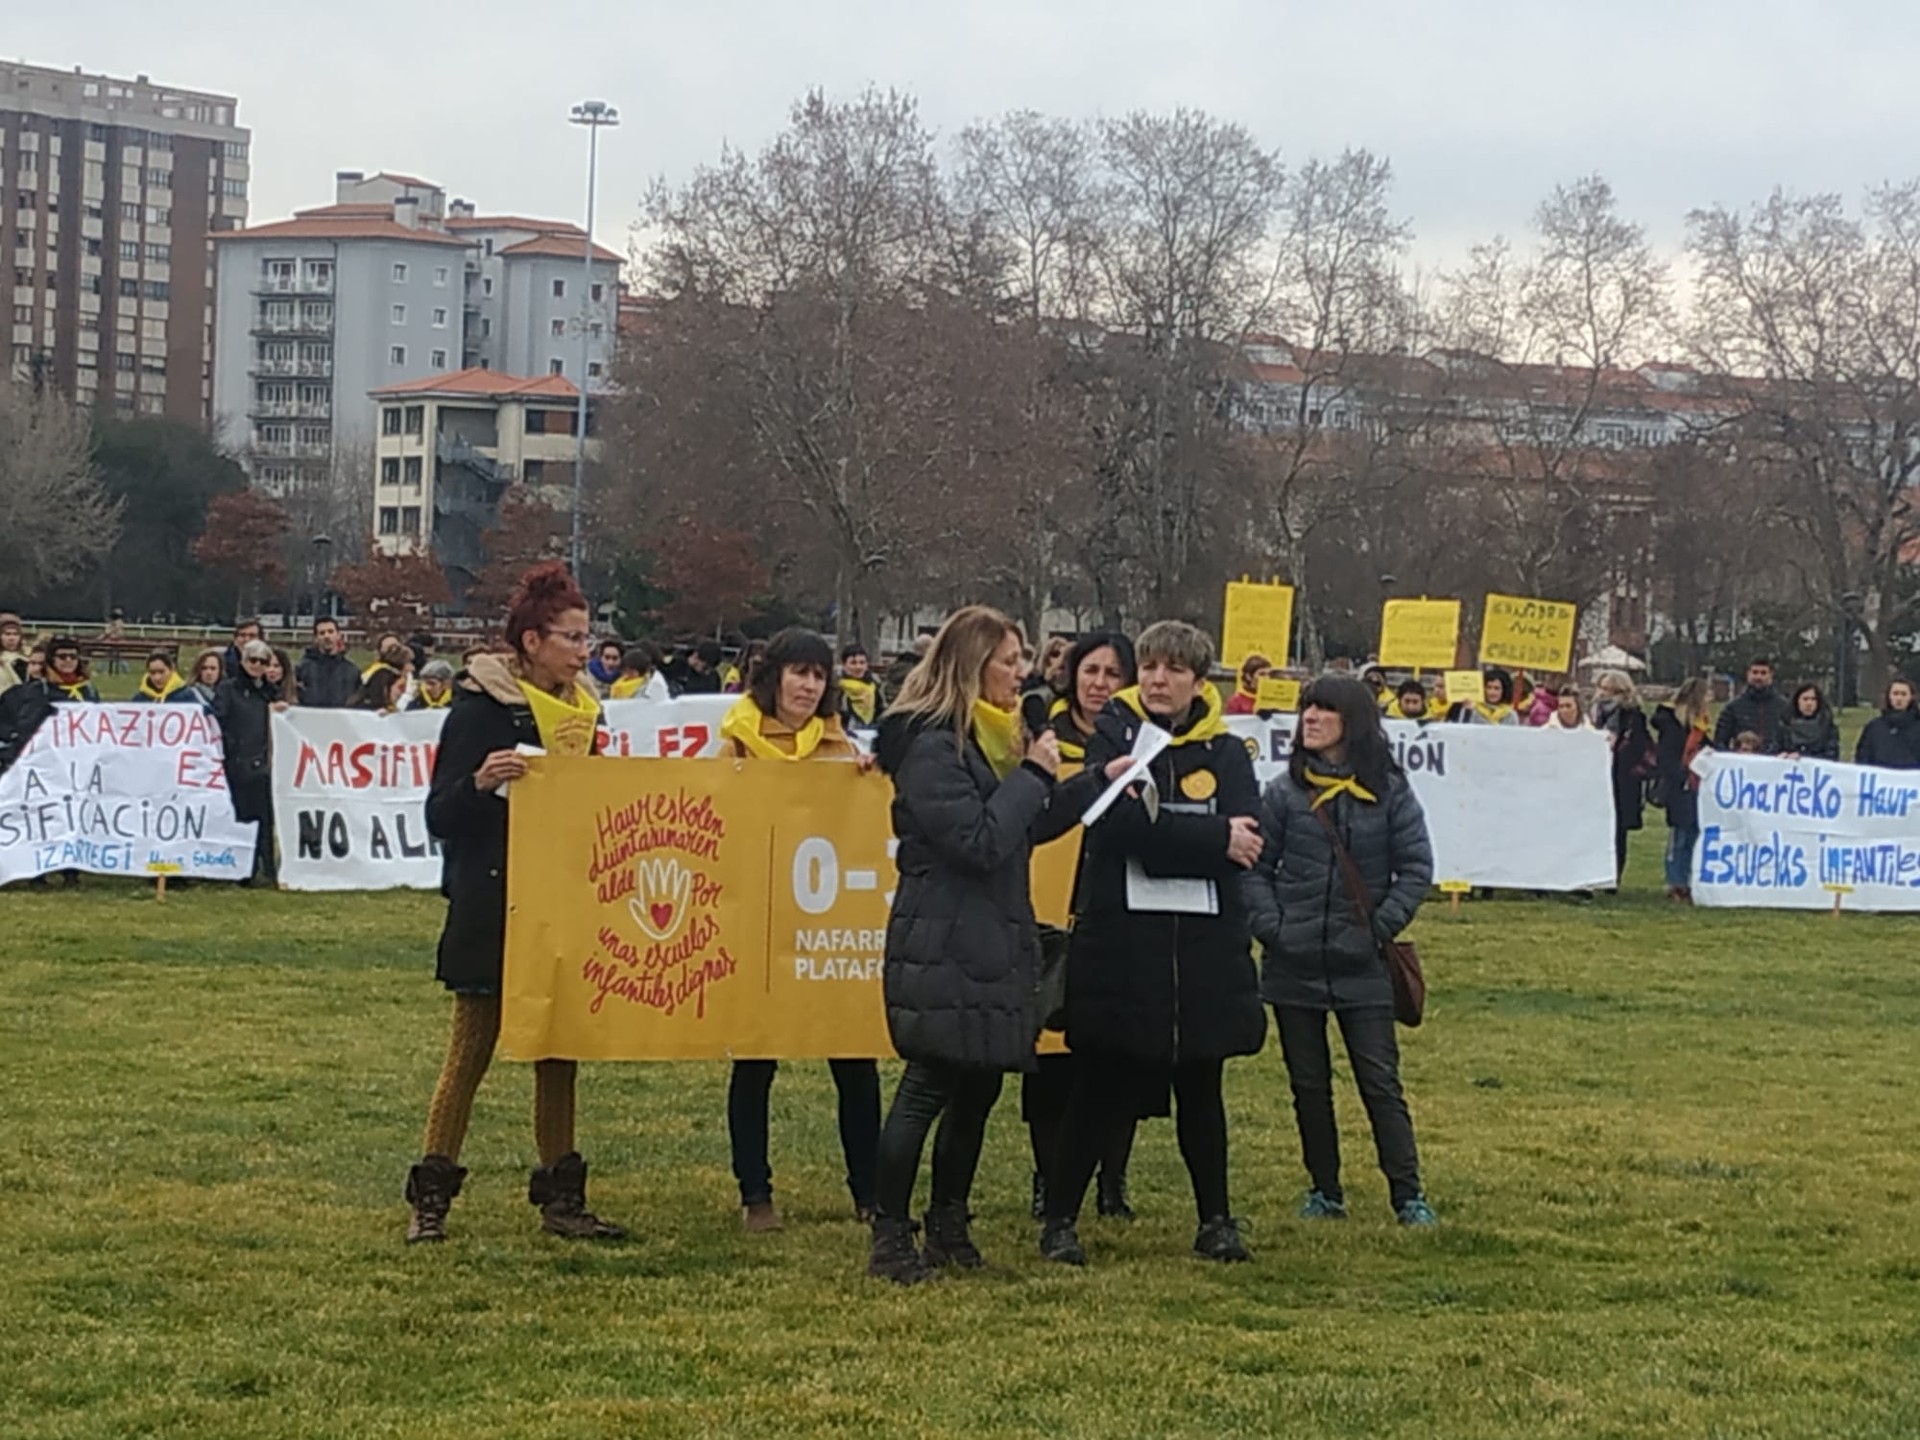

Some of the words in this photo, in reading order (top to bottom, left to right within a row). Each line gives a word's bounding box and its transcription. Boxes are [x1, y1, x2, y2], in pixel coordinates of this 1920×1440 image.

[25, 769, 48, 800] A
[70, 762, 102, 794] LA
[1858, 772, 1919, 817] Haur
[298, 810, 350, 860] NO
[598, 868, 636, 903] alde
[692, 872, 723, 908] Por
[793, 837, 900, 914] 0-
[599, 927, 640, 968] unas
